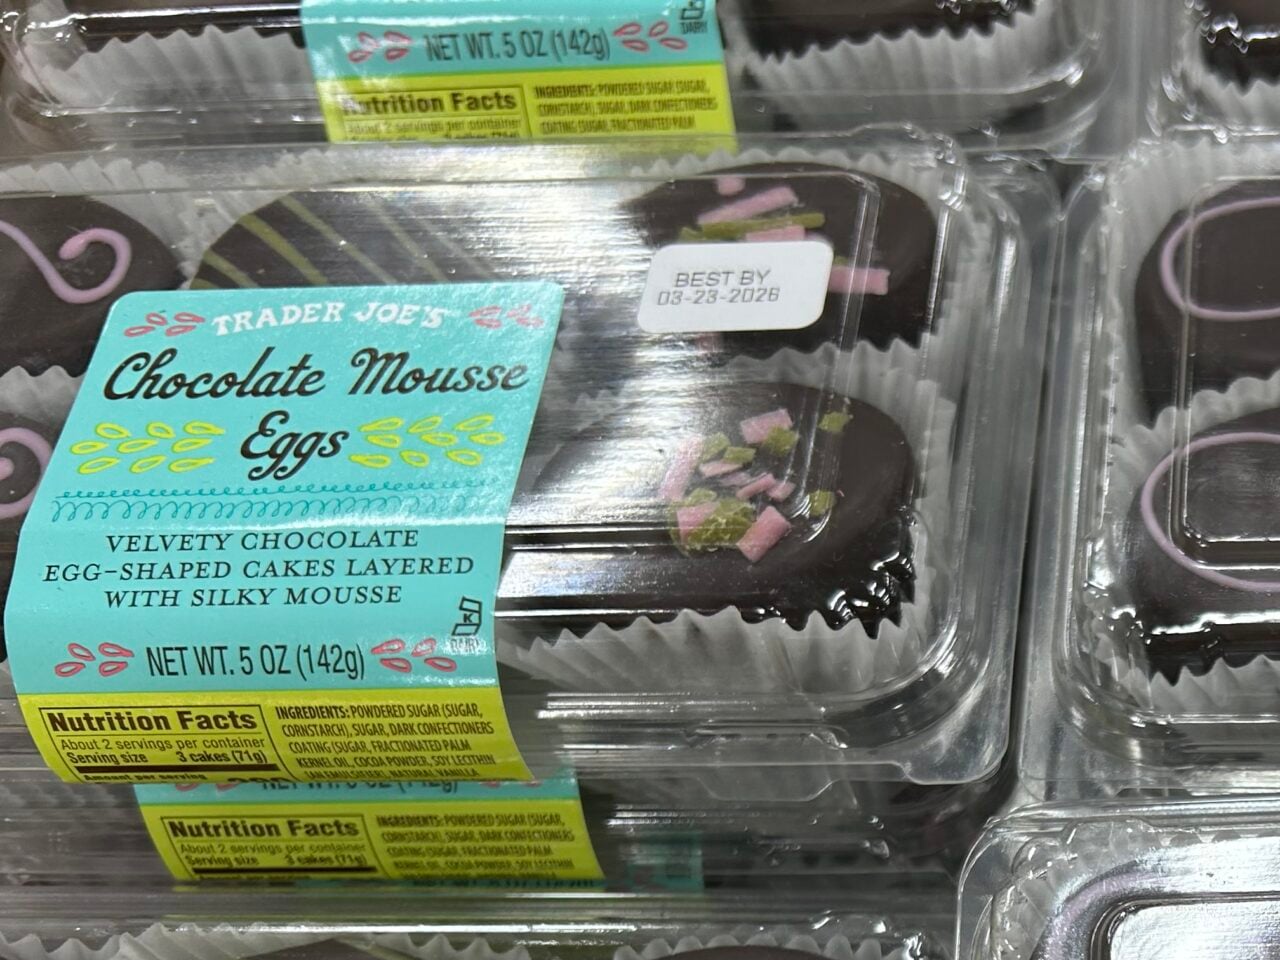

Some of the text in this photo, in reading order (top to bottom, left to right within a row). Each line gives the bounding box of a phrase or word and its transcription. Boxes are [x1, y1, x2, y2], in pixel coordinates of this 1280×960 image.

[425, 27, 611, 62] NET WT. 5 OZ (142g)
[451, 92, 517, 111] Facts
[674, 268, 772, 288] BEST BY
[211, 302, 343, 336] TRADER
[104, 347, 529, 400] Chocolate Mousse
[240, 411, 349, 481] Eggs
[105, 530, 419, 553] VELVETY CHOCOLATE
[42, 557, 474, 582] EGG-SHAPED CAKES LAYERED
[104, 586, 402, 608] WITH SILKY MOUSSE
[146, 644, 365, 680] NET WT. 5 OZ (142g)
[47, 710, 258, 732] Nutrition Facts
[61, 737, 265, 751] About 2 servings per container
[67, 750, 268, 766] Serving size 3 cakes (71g)
[168, 819, 359, 838] Nutrition Facts
